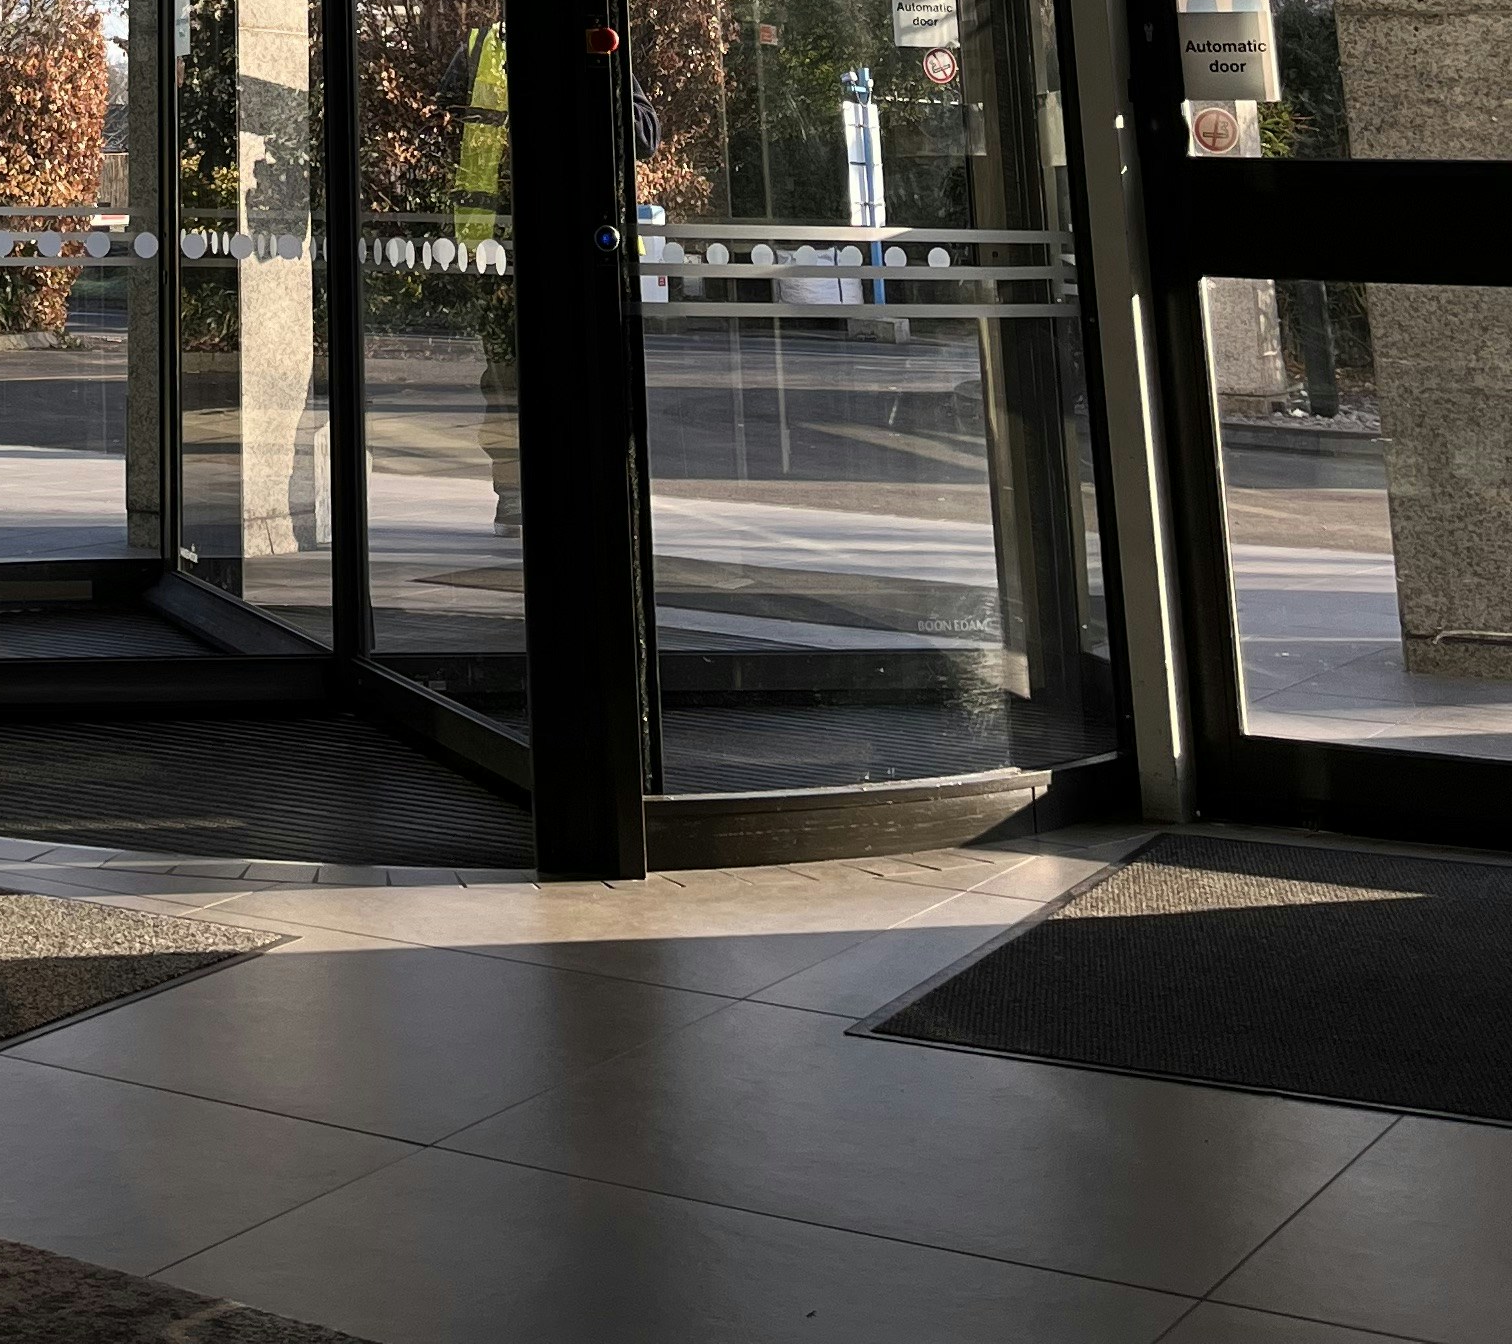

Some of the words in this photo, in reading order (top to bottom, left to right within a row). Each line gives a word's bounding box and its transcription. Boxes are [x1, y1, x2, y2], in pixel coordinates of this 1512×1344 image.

[896, 2, 953, 13] Automatic
[912, 17, 938, 26] door
[1185, 40, 1267, 53] Automatic
[1209, 59, 1247, 73] door
[917, 620, 952, 631] BOON
